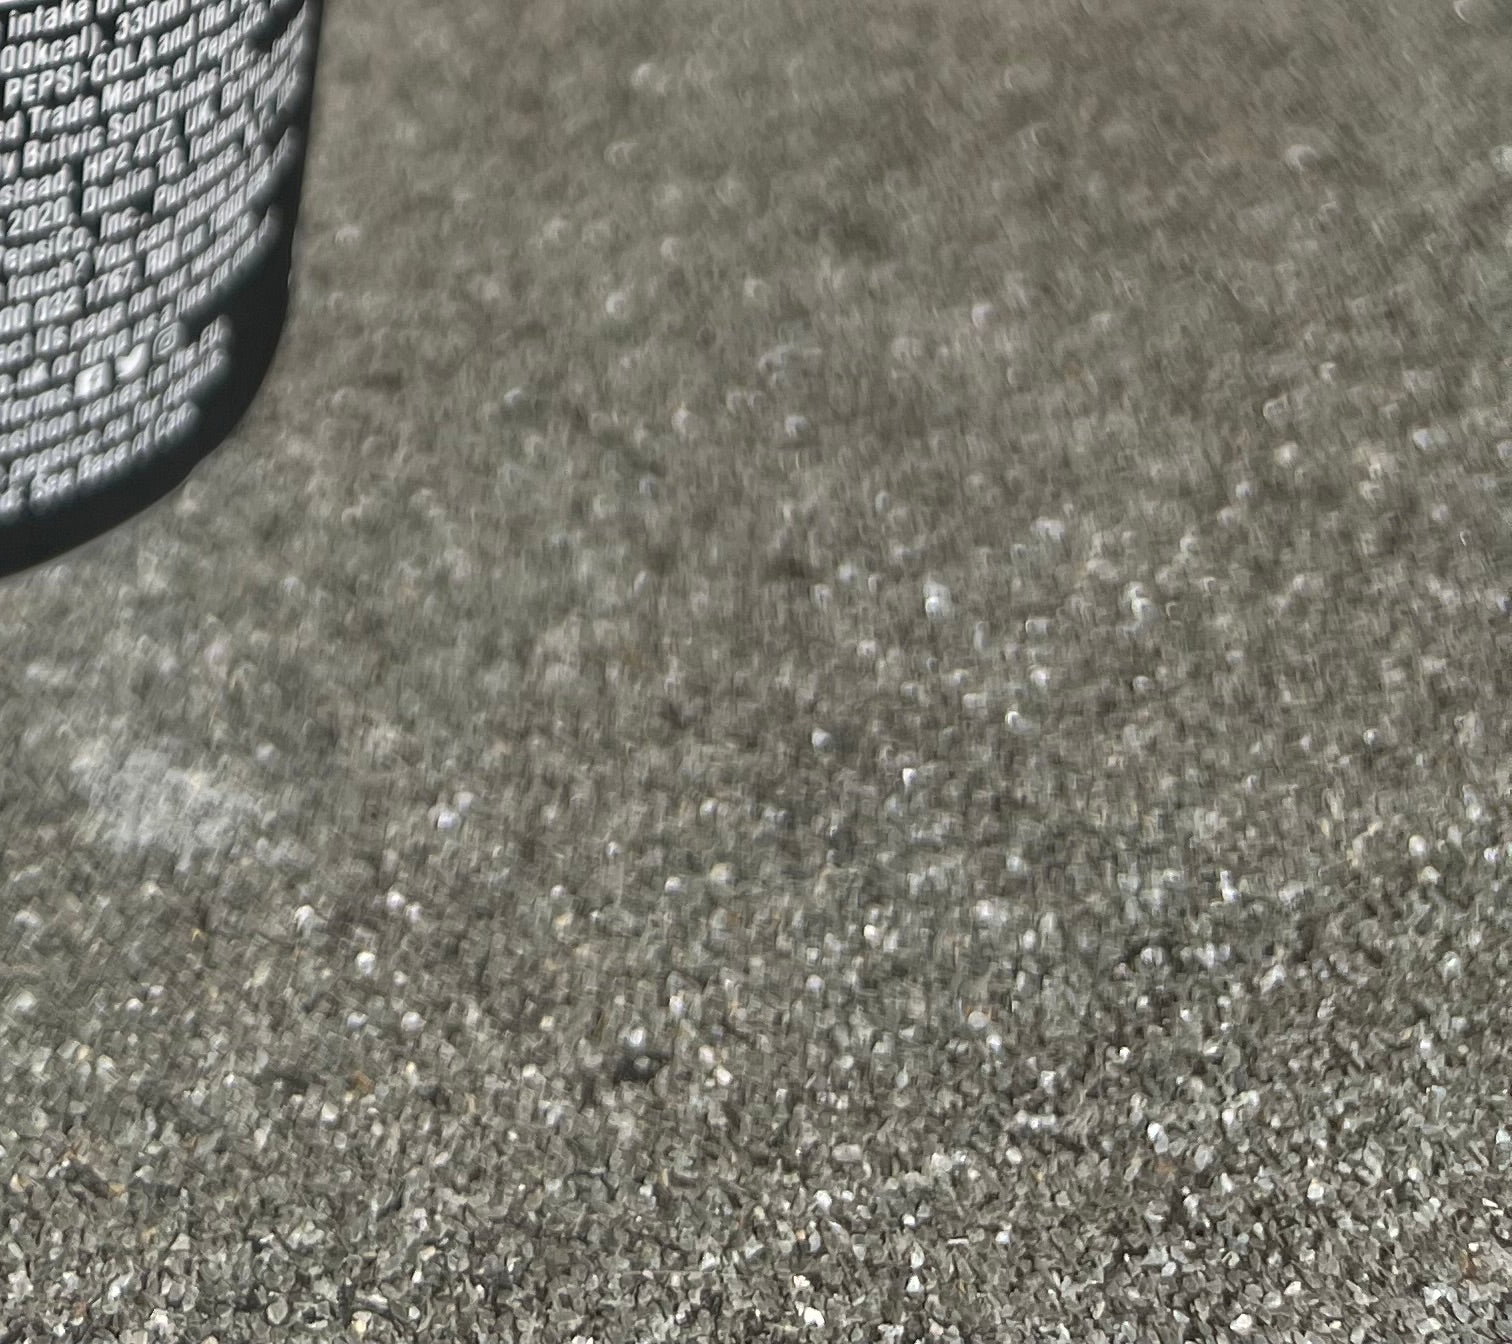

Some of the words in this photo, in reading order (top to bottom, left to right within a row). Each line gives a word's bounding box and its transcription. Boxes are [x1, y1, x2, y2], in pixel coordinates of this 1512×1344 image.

[3, 34, 156, 109] PEPSI-COLA
[157, 12, 198, 53] and
[198, 0, 229, 34] the
[27, 93, 99, 137] Trade
[101, 64, 171, 112] Marks
[172, 45, 194, 81] of
[195, 2, 267, 67] PepsiCo,
[22, 123, 106, 170] Britvic
[107, 98, 155, 142] Soft
[156, 66, 221, 116] Drinks
[82, 142, 135, 186] HP2
[82, 167, 156, 214] Dublin
